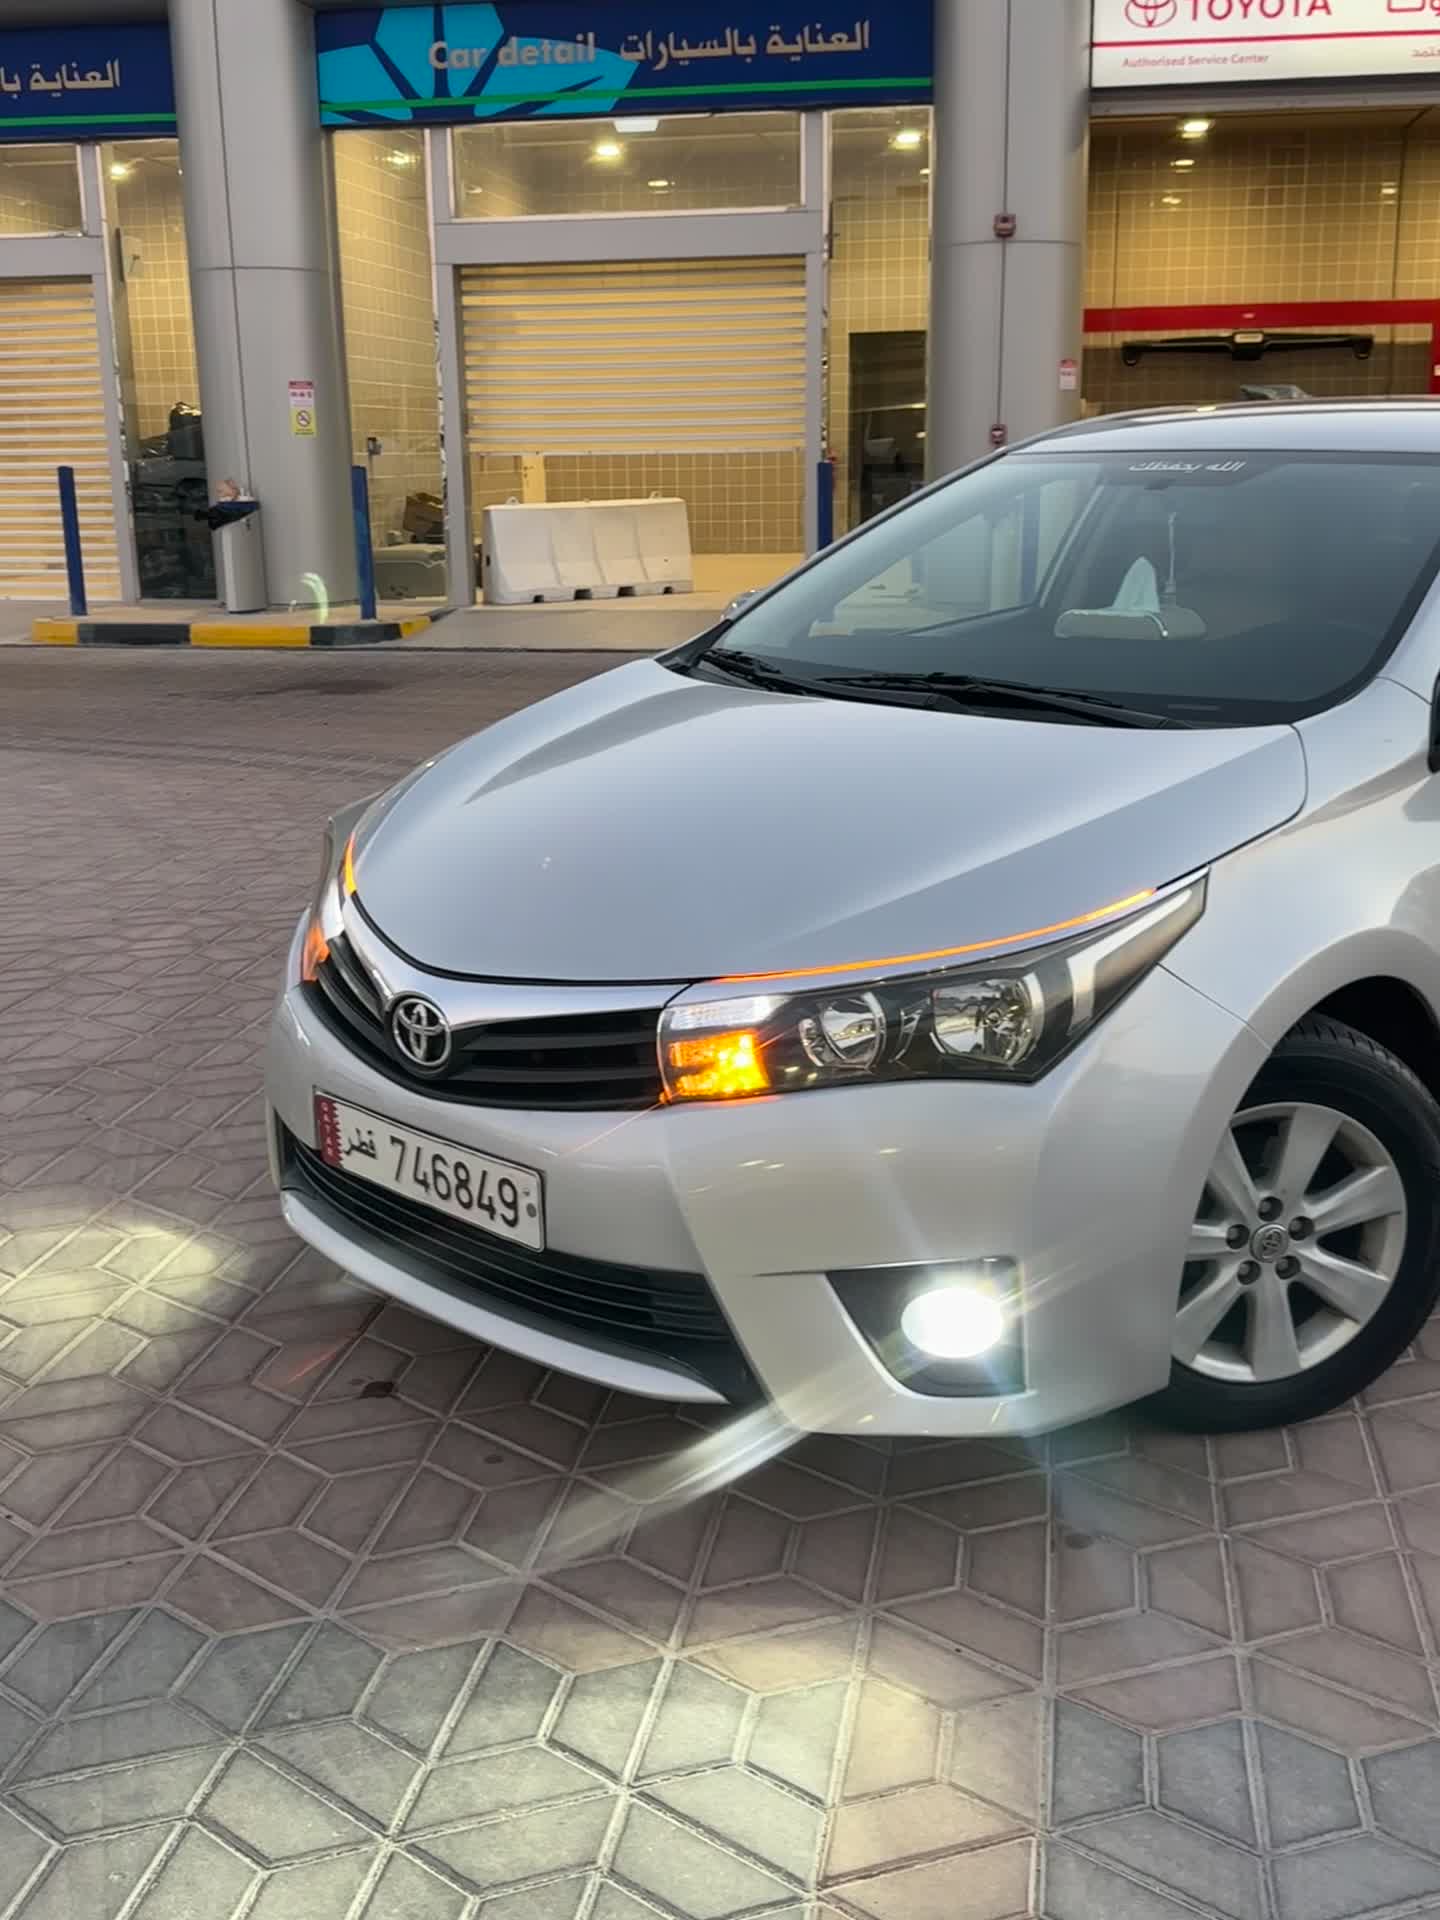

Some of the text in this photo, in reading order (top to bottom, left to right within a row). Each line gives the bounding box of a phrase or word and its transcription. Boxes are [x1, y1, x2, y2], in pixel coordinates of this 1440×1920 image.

[1189, 0, 1332, 21] TOYOTA
[428, 31, 596, 70] Car detail
[619, 20, 870, 71] العناية بالسيارات
[1121, 53, 1269, 68] Authorised Service Center
[30, 58, 120, 98] العناية
[1205, 460, 1247, 472] الله
[343, 1127, 379, 1160] قطر
[389, 1134, 520, 1229] 746849
